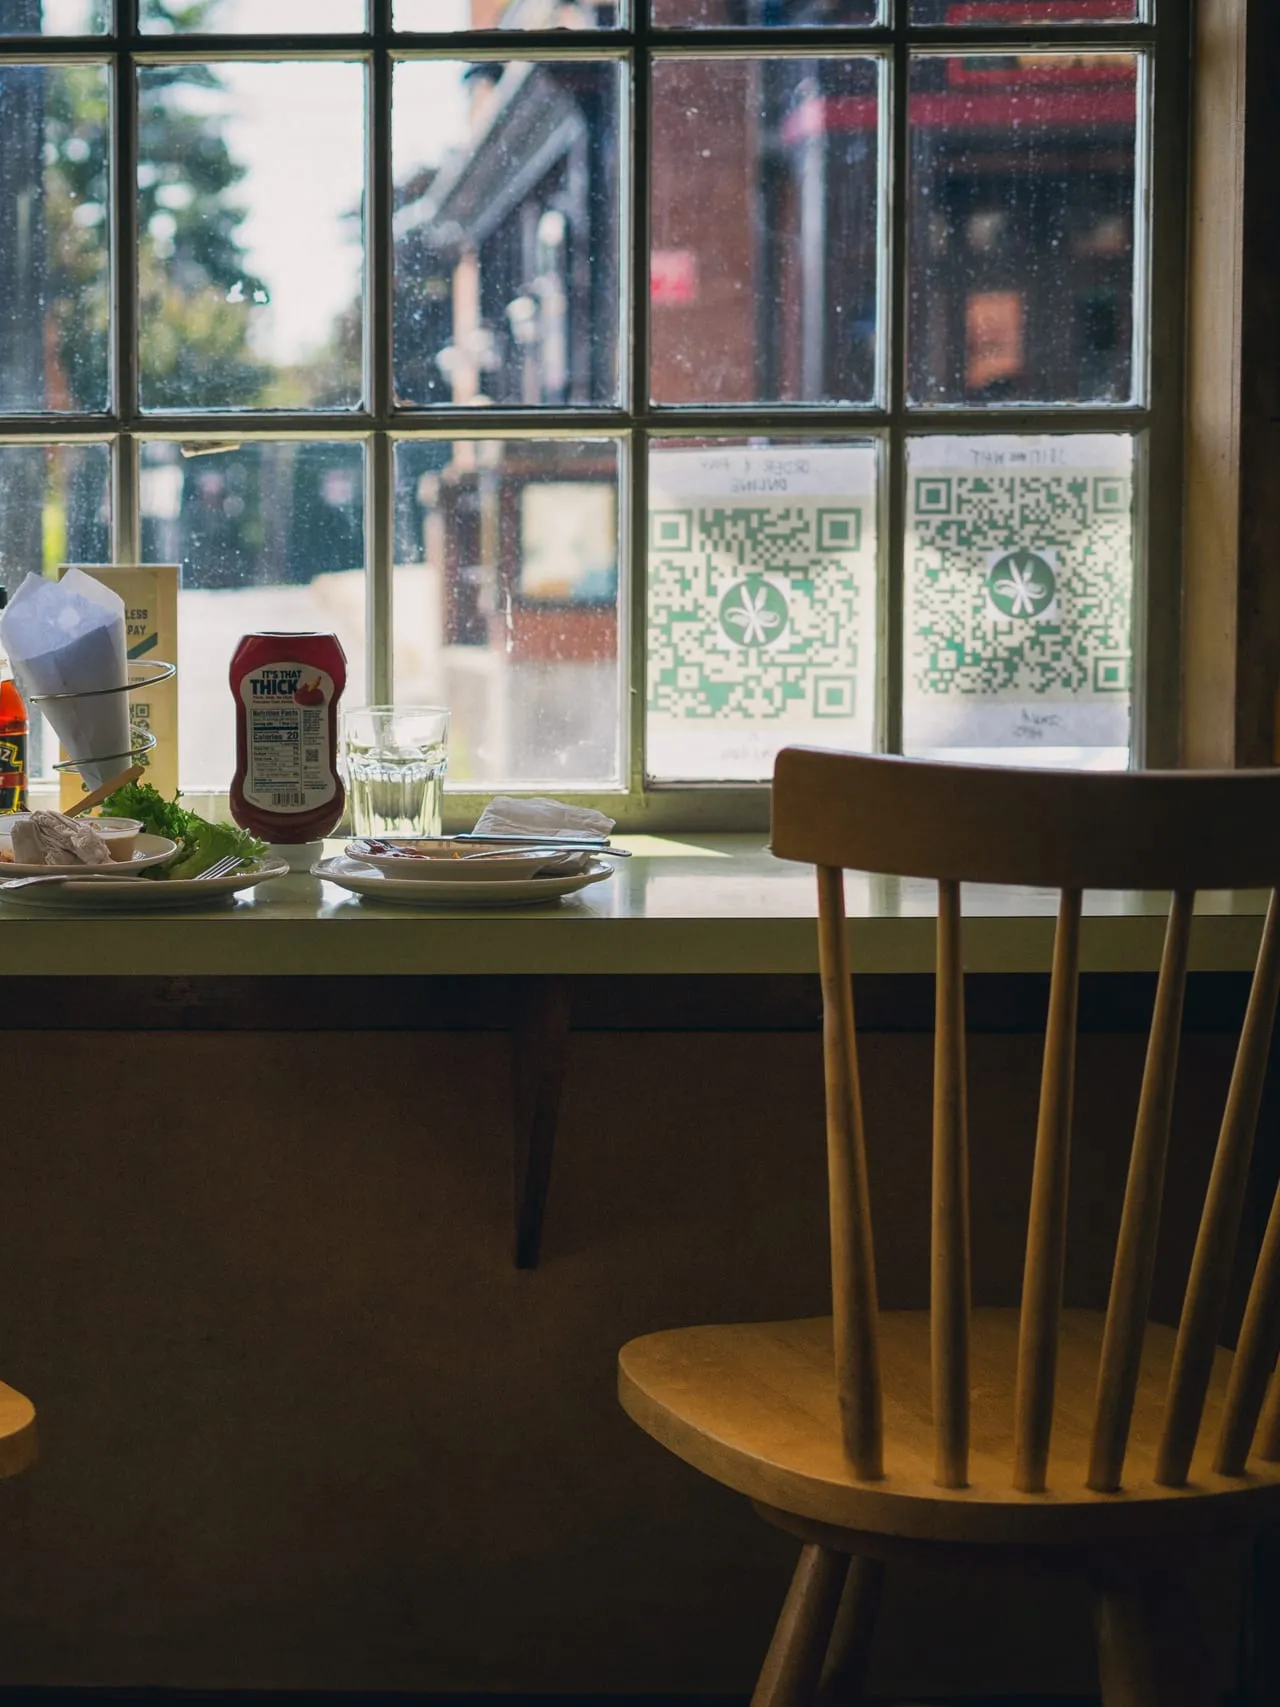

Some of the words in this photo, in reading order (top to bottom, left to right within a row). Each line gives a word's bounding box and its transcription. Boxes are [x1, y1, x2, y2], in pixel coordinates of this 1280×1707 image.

[125, 609, 148, 620] LESS
[127, 625, 147, 636] PAY
[262, 670, 278, 679] IT'S
[280, 670, 302, 679] THAT
[250, 679, 299, 695] THICK
[287, 731, 299, 740] 20
